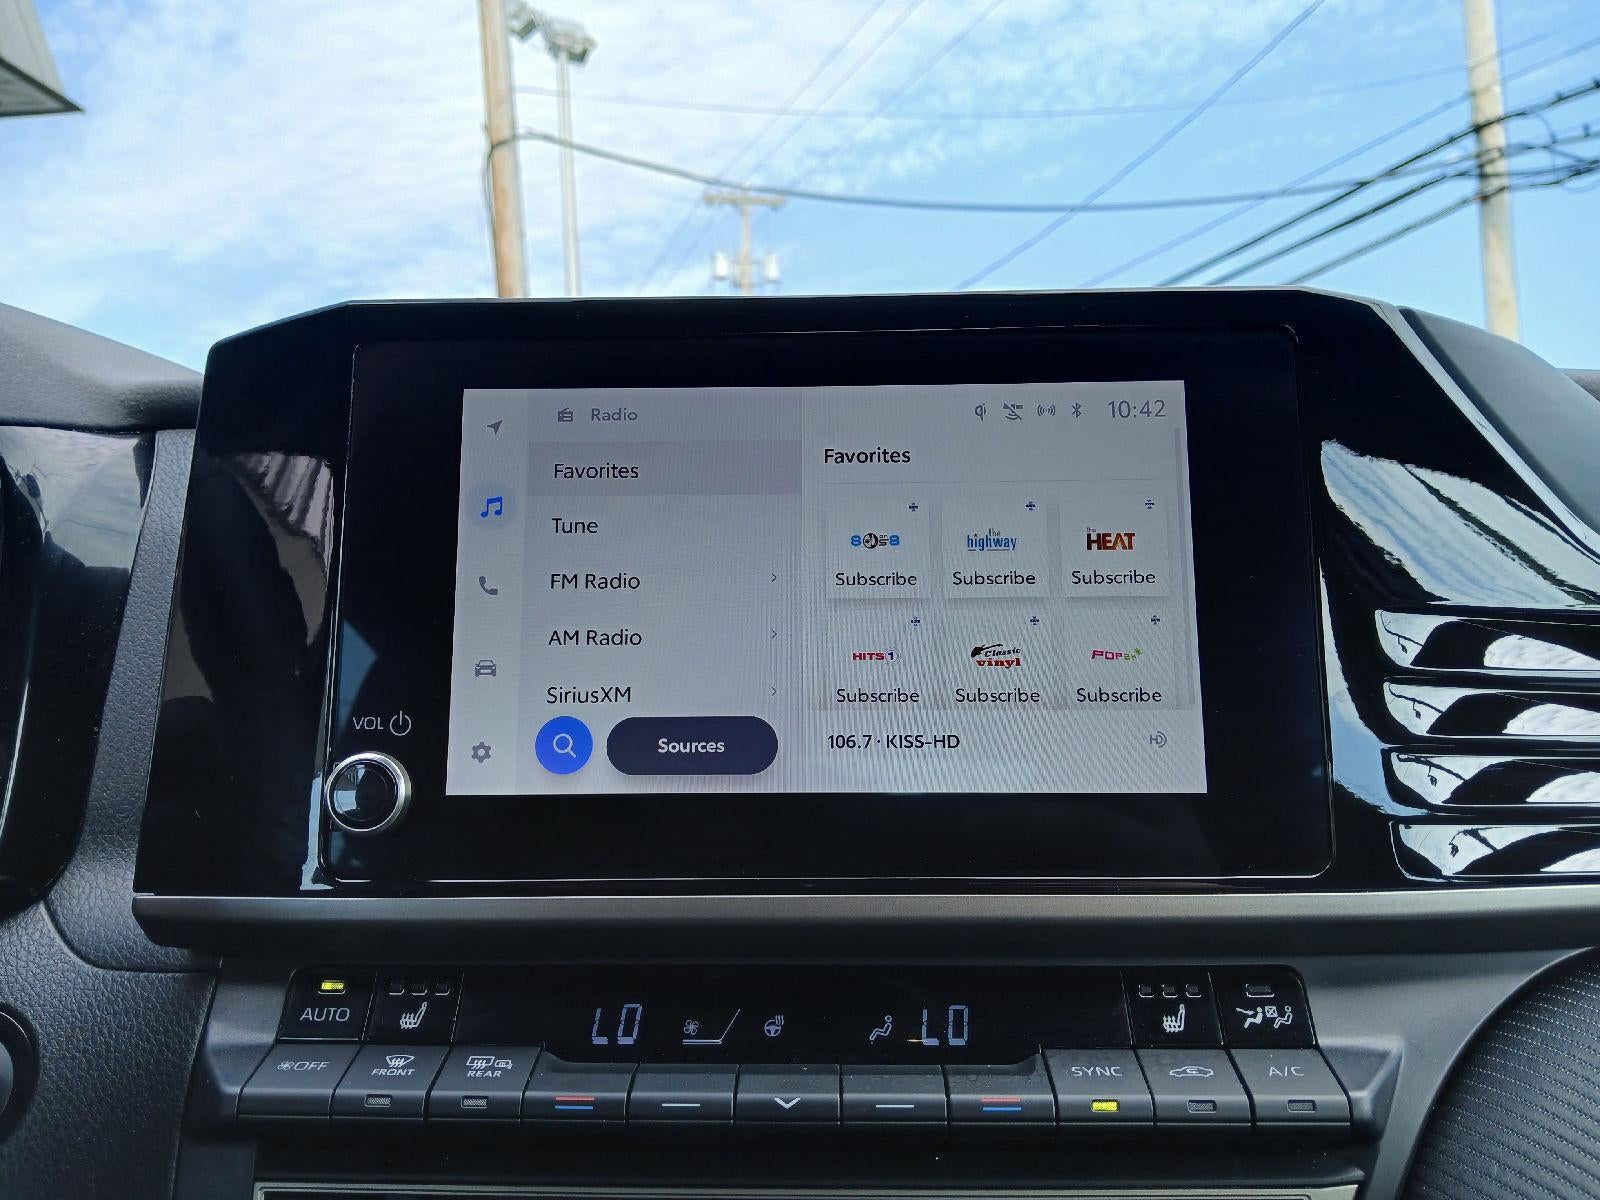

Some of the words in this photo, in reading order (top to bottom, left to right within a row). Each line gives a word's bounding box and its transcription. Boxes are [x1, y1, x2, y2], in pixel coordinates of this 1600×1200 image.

[591, 407, 638, 422] Radio
[1107, 399, 1166, 419] 10:42
[824, 447, 911, 464] Favorites
[553, 463, 639, 479] Favorites
[552, 517, 599, 534] Tune
[967, 533, 1017, 551] highway
[1086, 533, 1135, 551] HEAT
[550, 573, 578, 590] FM
[585, 572, 641, 590] Radio
[835, 571, 917, 586] Subscribe
[952, 570, 1036, 585] Subscribe
[1071, 569, 1156, 584] Subscribe
[548, 630, 579, 646] AM
[586, 629, 642, 646] Radio
[852, 651, 885, 661] HITS
[984, 647, 1021, 658] Classic
[976, 657, 1022, 669] vinyl
[546, 686, 632, 704] SiriusXM
[836, 687, 920, 703] Subscribe
[955, 687, 1040, 703] Subscribe
[1076, 686, 1162, 703] Subscribe
[352, 716, 384, 730] VOL
[657, 738, 725, 754] Sources
[827, 734, 872, 749] 106.7
[885, 734, 960, 749] KISS-HD
[300, 1007, 351, 1023] AUTO
[592, 1004, 643, 1045] LO
[921, 1004, 969, 1046] LO
[293, 1060, 329, 1072] OFF
[371, 1068, 416, 1077] FRONT
[466, 1069, 502, 1078] REAR
[1070, 1065, 1123, 1078] SYNC
[1268, 1065, 1305, 1078] A/C
